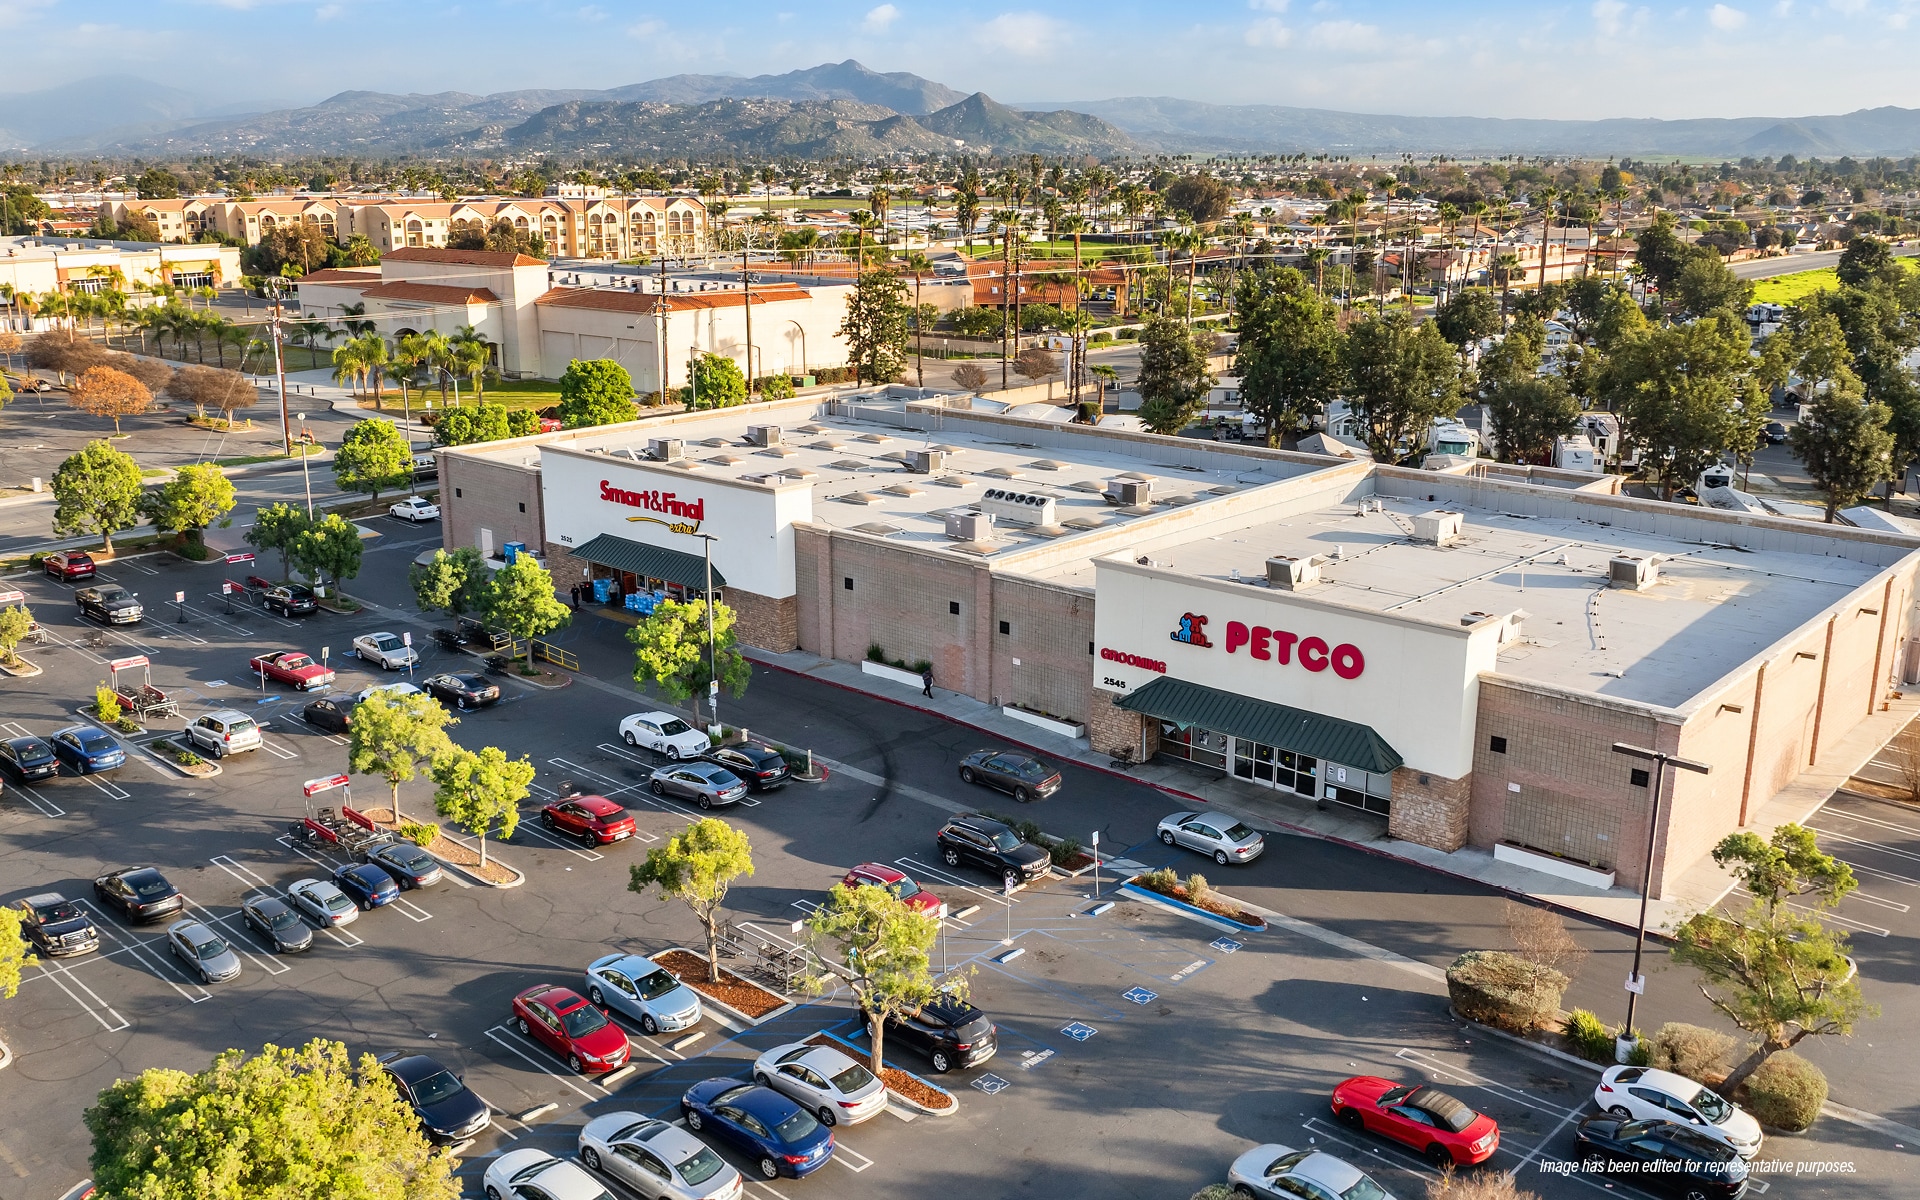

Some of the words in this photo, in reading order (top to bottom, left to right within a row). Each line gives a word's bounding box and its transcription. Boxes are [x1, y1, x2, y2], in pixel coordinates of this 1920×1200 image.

[600, 480, 704, 521] Smart&Final
[560, 534, 573, 544] 2525
[1100, 647, 1167, 674] GROOMING
[1225, 620, 1365, 680] PETCO
[1103, 676, 1126, 689] 2545
[1020, 1048, 1055, 1069] PARKING
